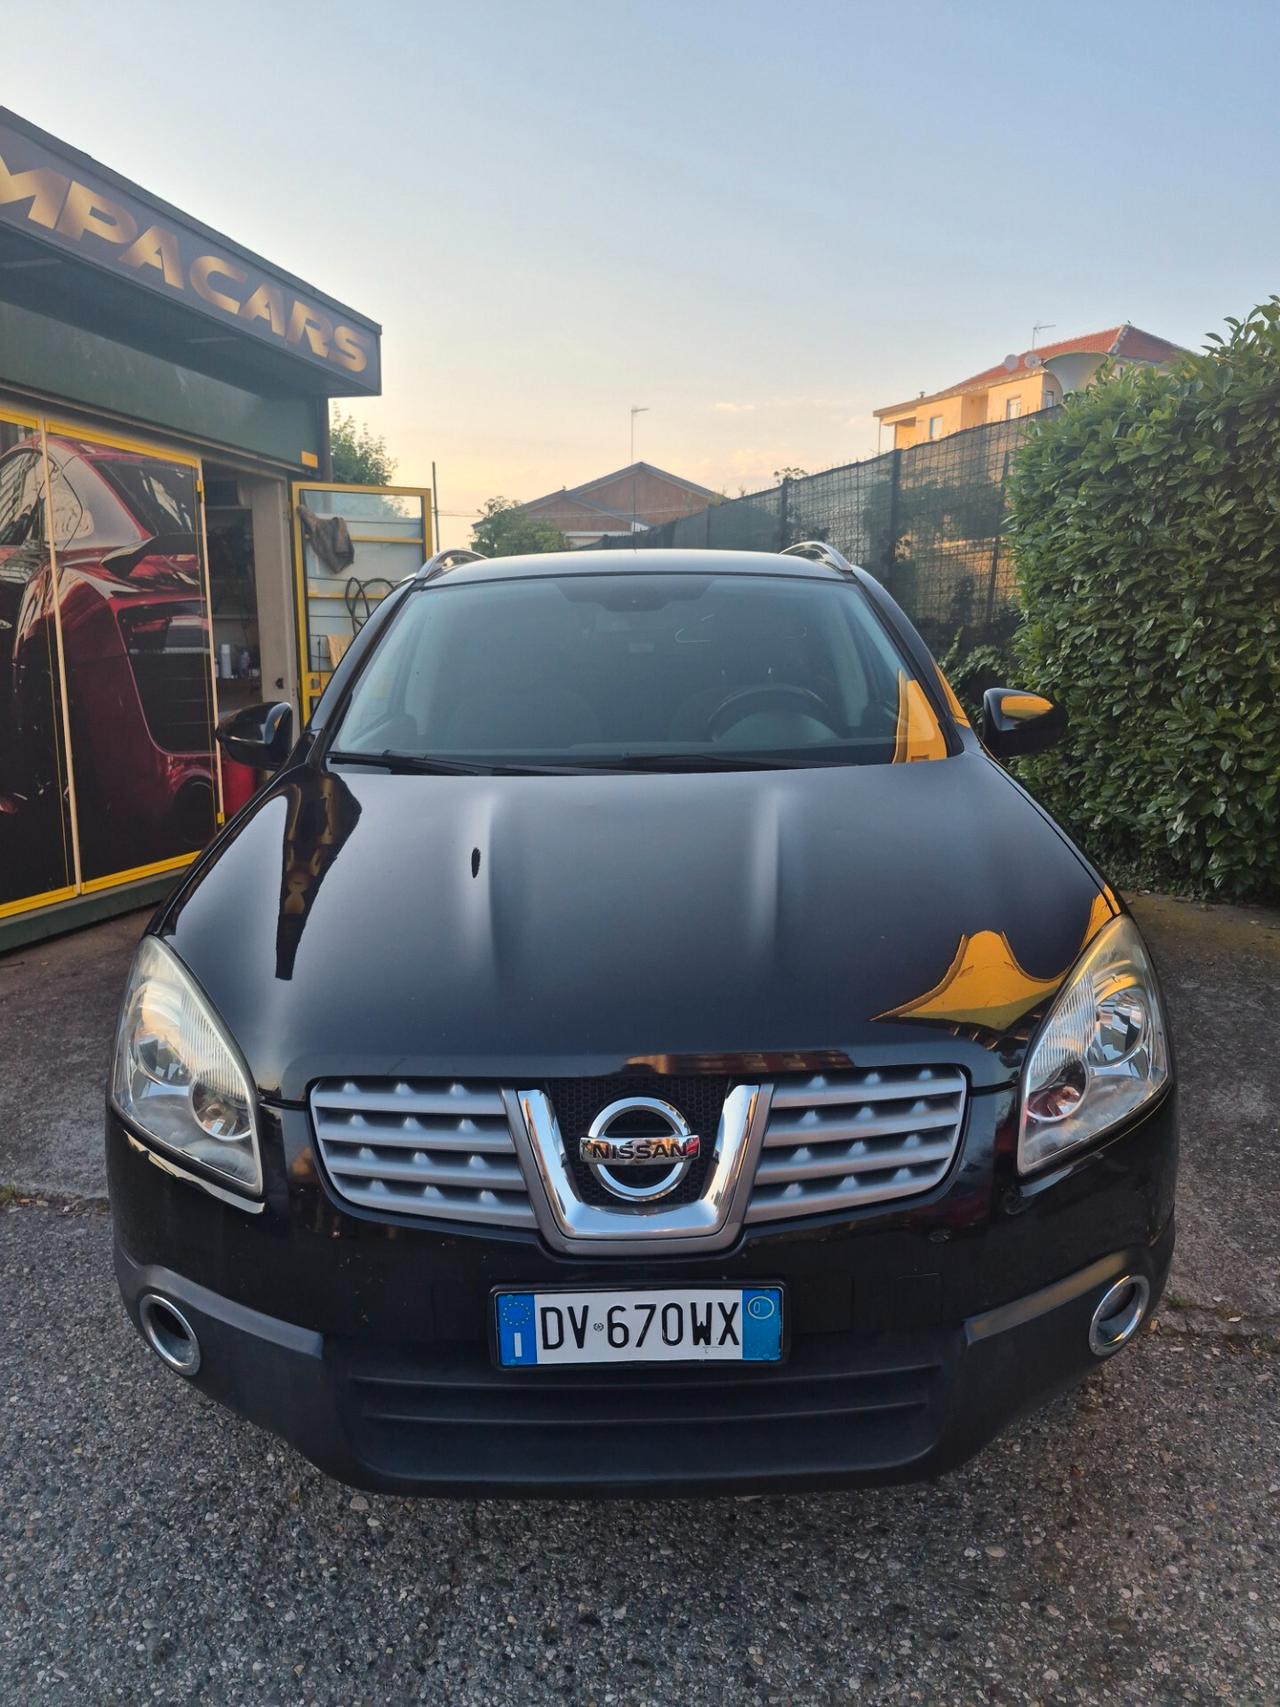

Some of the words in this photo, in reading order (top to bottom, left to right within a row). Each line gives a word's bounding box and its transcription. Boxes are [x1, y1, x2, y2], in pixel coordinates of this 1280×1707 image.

[592, 1143, 687, 1160] NISSAN
[540, 1304, 589, 1351] DV
[606, 1301, 740, 1348] 670WX
[513, 1332, 523, 1358] I
